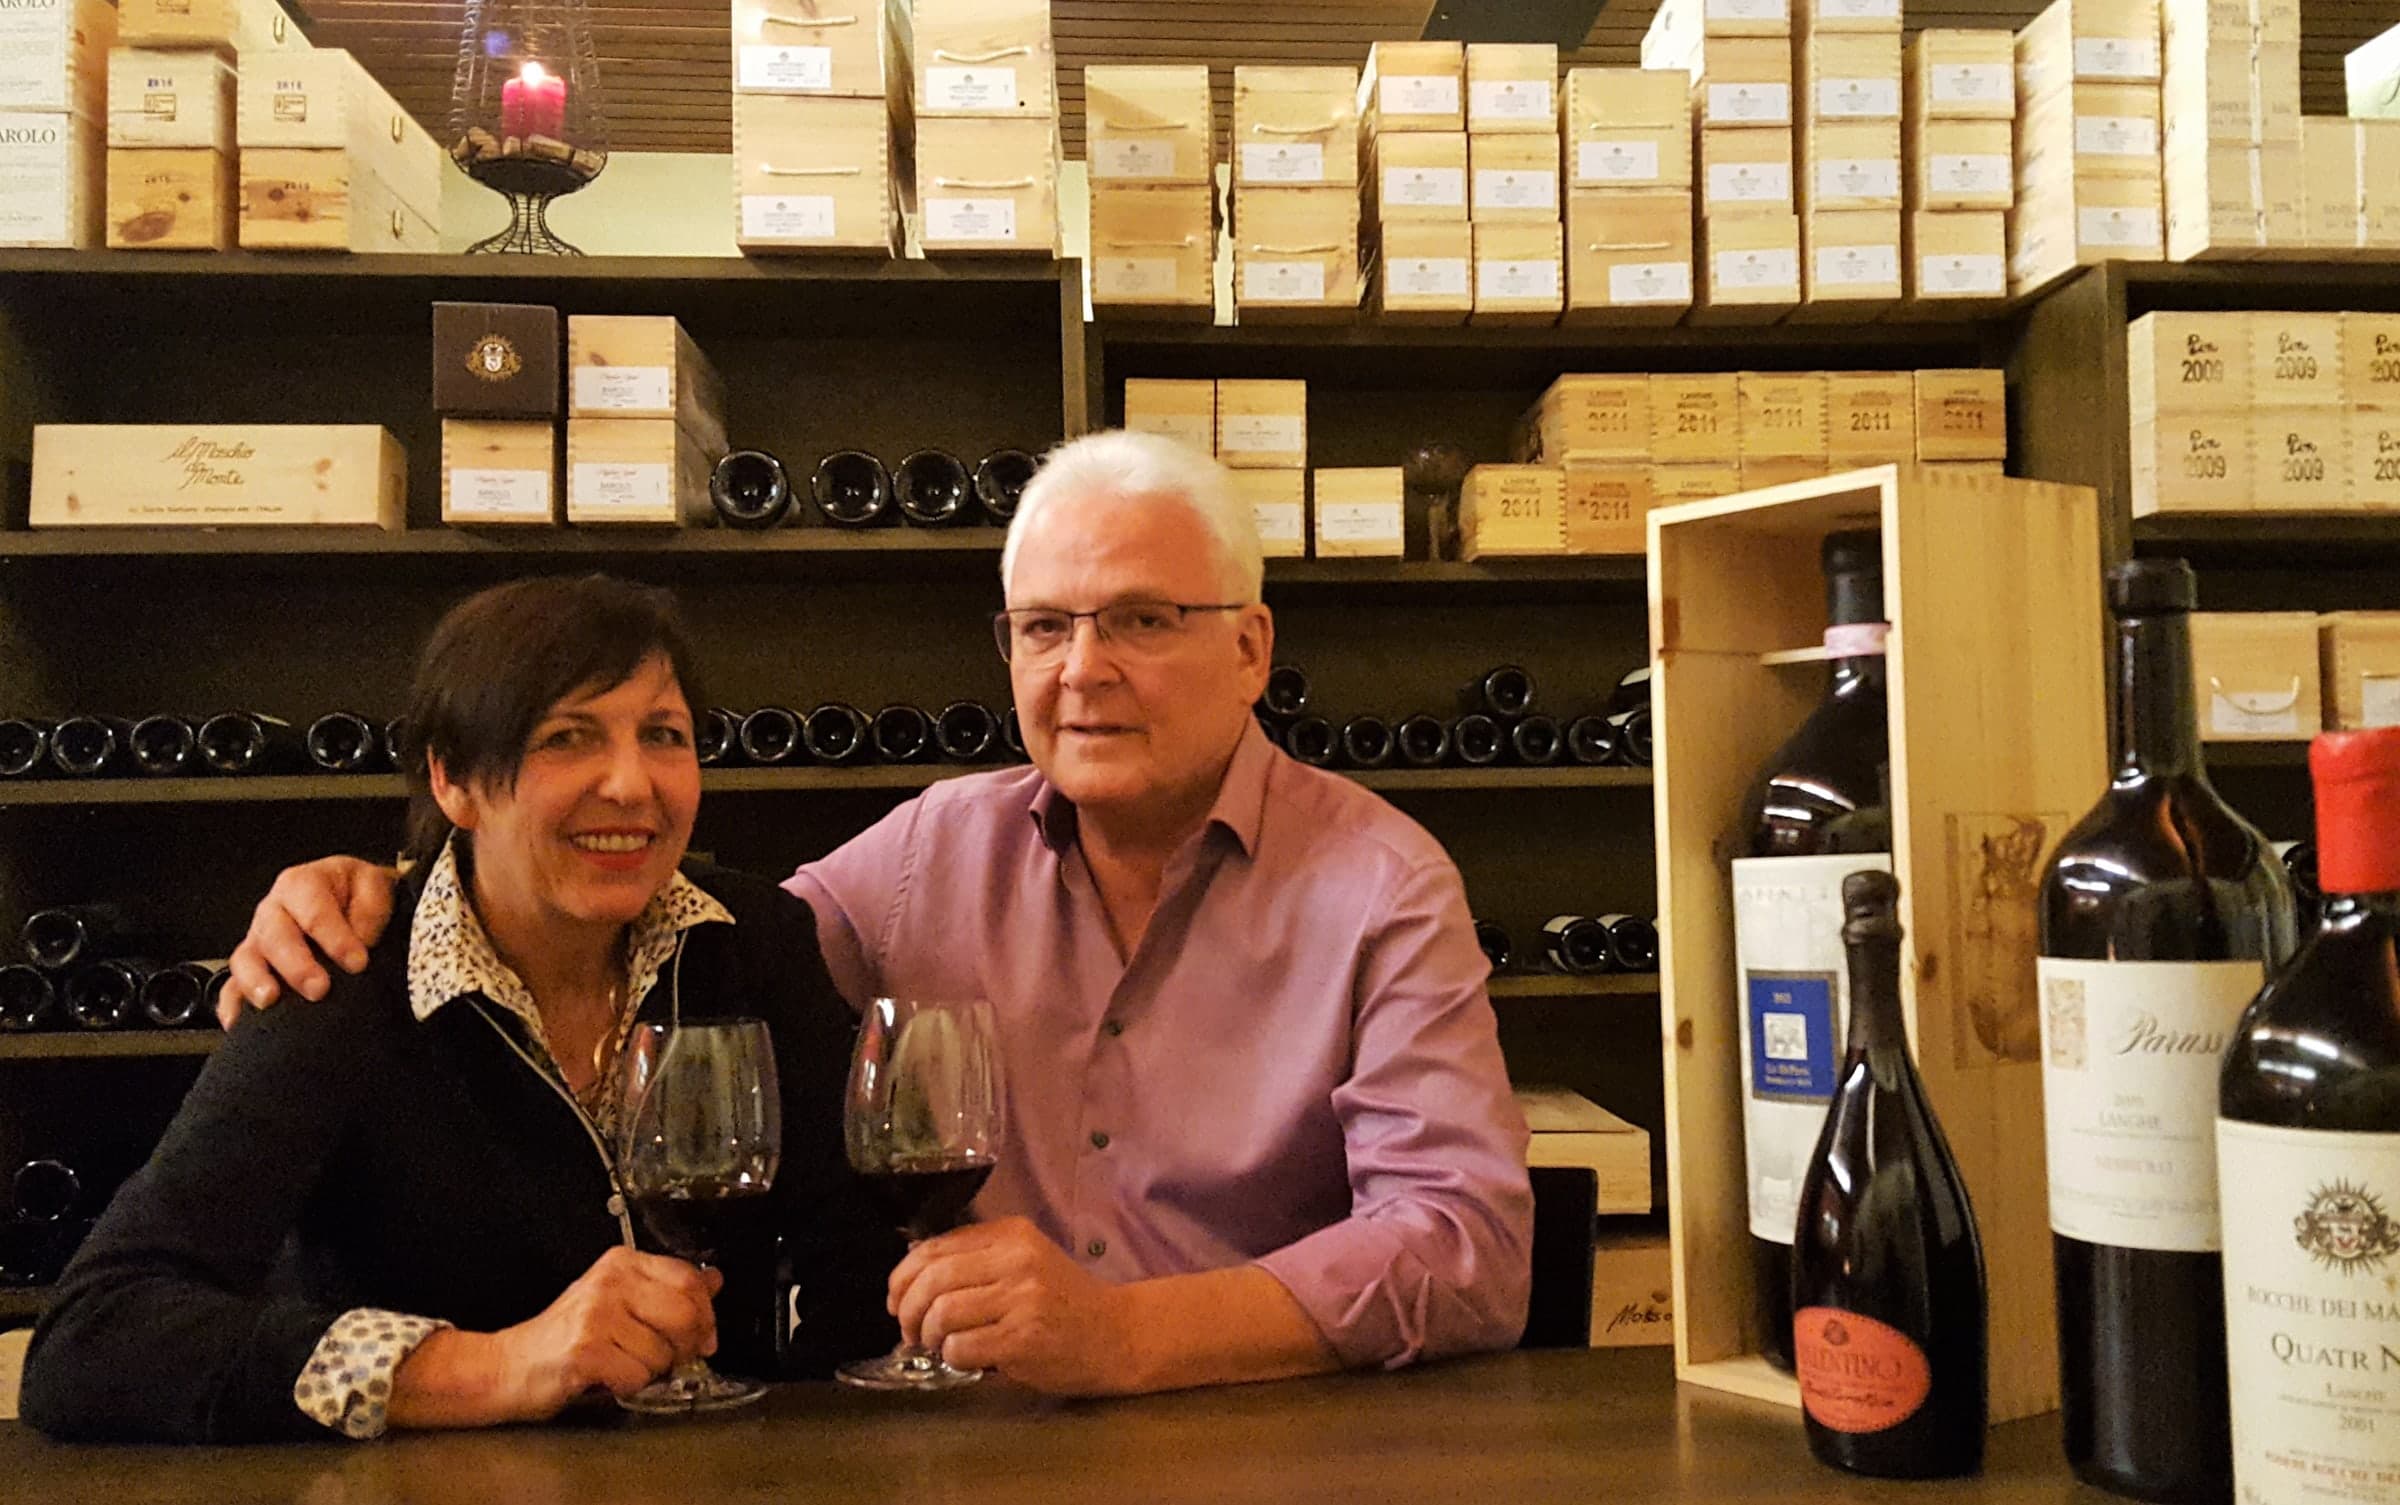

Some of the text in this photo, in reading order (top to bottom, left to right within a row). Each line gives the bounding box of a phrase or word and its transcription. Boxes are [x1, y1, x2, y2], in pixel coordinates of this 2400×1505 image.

[2181, 359, 2224, 383] 2009
[2274, 356, 2319, 380] 2009
[2370, 359, 2400, 383] 200
[1588, 411, 1628, 433] 2011
[1677, 412, 1718, 433] 2011
[1850, 411, 1892, 432] 2011
[2183, 455, 2227, 479] 2009
[2282, 457, 2325, 482] 2009
[2374, 458, 2400, 481] 200
[1500, 498, 1542, 518] 2011
[1589, 501, 1630, 521] 2011
[2321, 1297, 2357, 1319] DEI
